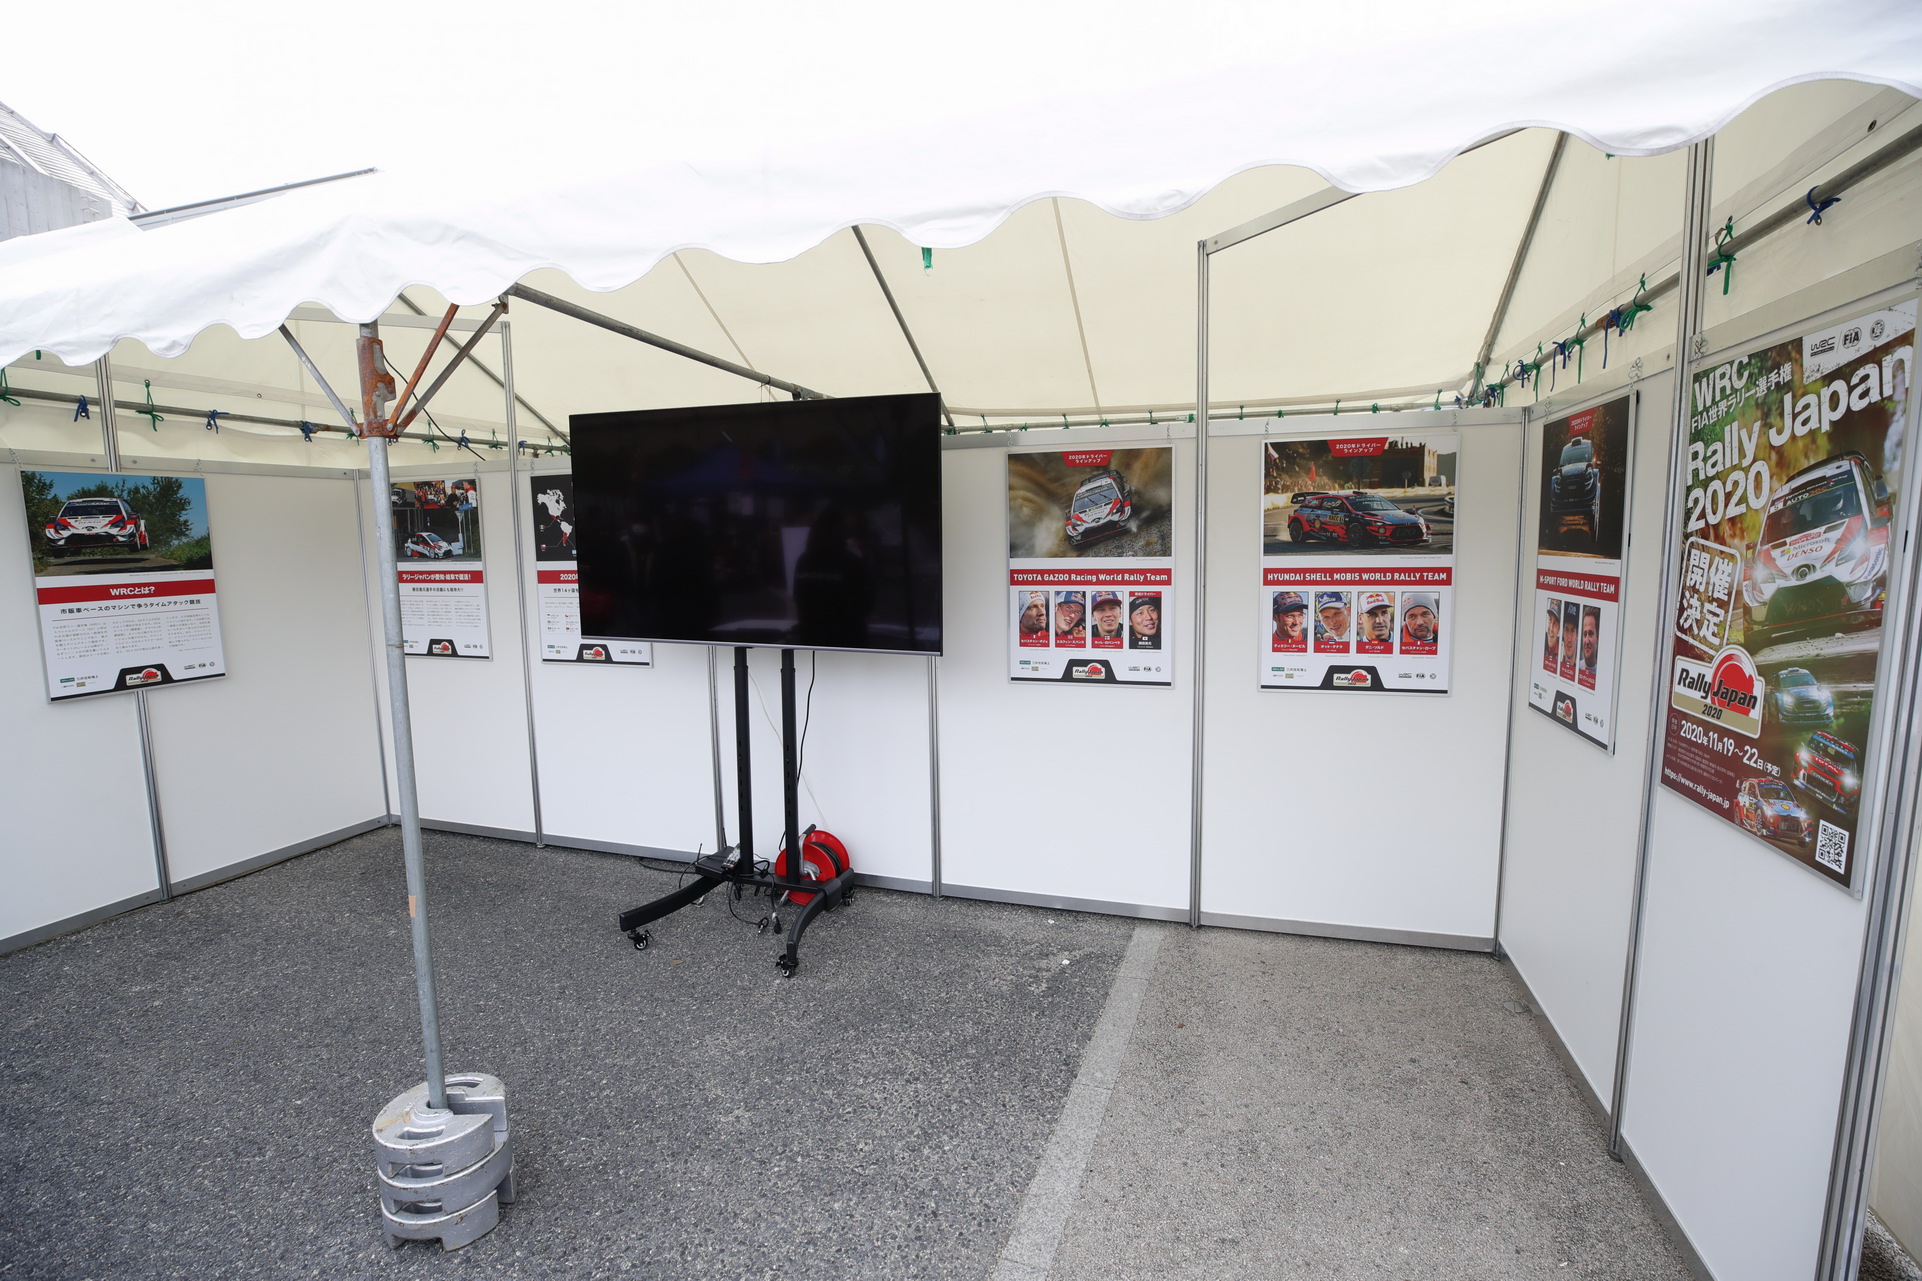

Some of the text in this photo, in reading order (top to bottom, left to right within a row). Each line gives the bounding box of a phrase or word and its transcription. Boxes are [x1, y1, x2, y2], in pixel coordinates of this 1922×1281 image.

[1810, 336, 1836, 351] WRC
[1694, 355, 1750, 412] WRC
[1691, 361, 1793, 434] FIA世界ラリー選手権
[1686, 345, 1914, 487] Rally Japan
[1687, 460, 1771, 533] 2020
[1786, 545, 1823, 561] DENSO
[1792, 537, 1831, 551] Microsoft
[1043, 573, 1069, 581] GAZOO
[1071, 573, 1097, 582] Racing
[1099, 573, 1122, 581] World
[1124, 573, 1145, 582] Rally
[1145, 573, 1168, 581] Team
[1267, 572, 1447, 581] HYUNDAI SHELL MOBIS WORLD RALLY TEAM
[1540, 575, 1615, 594] M-SPORT FORD WORLD RALLY TEAM
[1686, 548, 1734, 602] 開催
[110, 586, 155, 597] WRCとは?
[60, 599, 202, 615] 市販車ベースのマシンで争うタイムアタック競技
[1680, 590, 1725, 646] 決定
[1677, 667, 1758, 710] Rally Japan
[1701, 704, 1723, 720] 2020
[1664, 766, 1730, 810] https://www.rally-japan.jp
